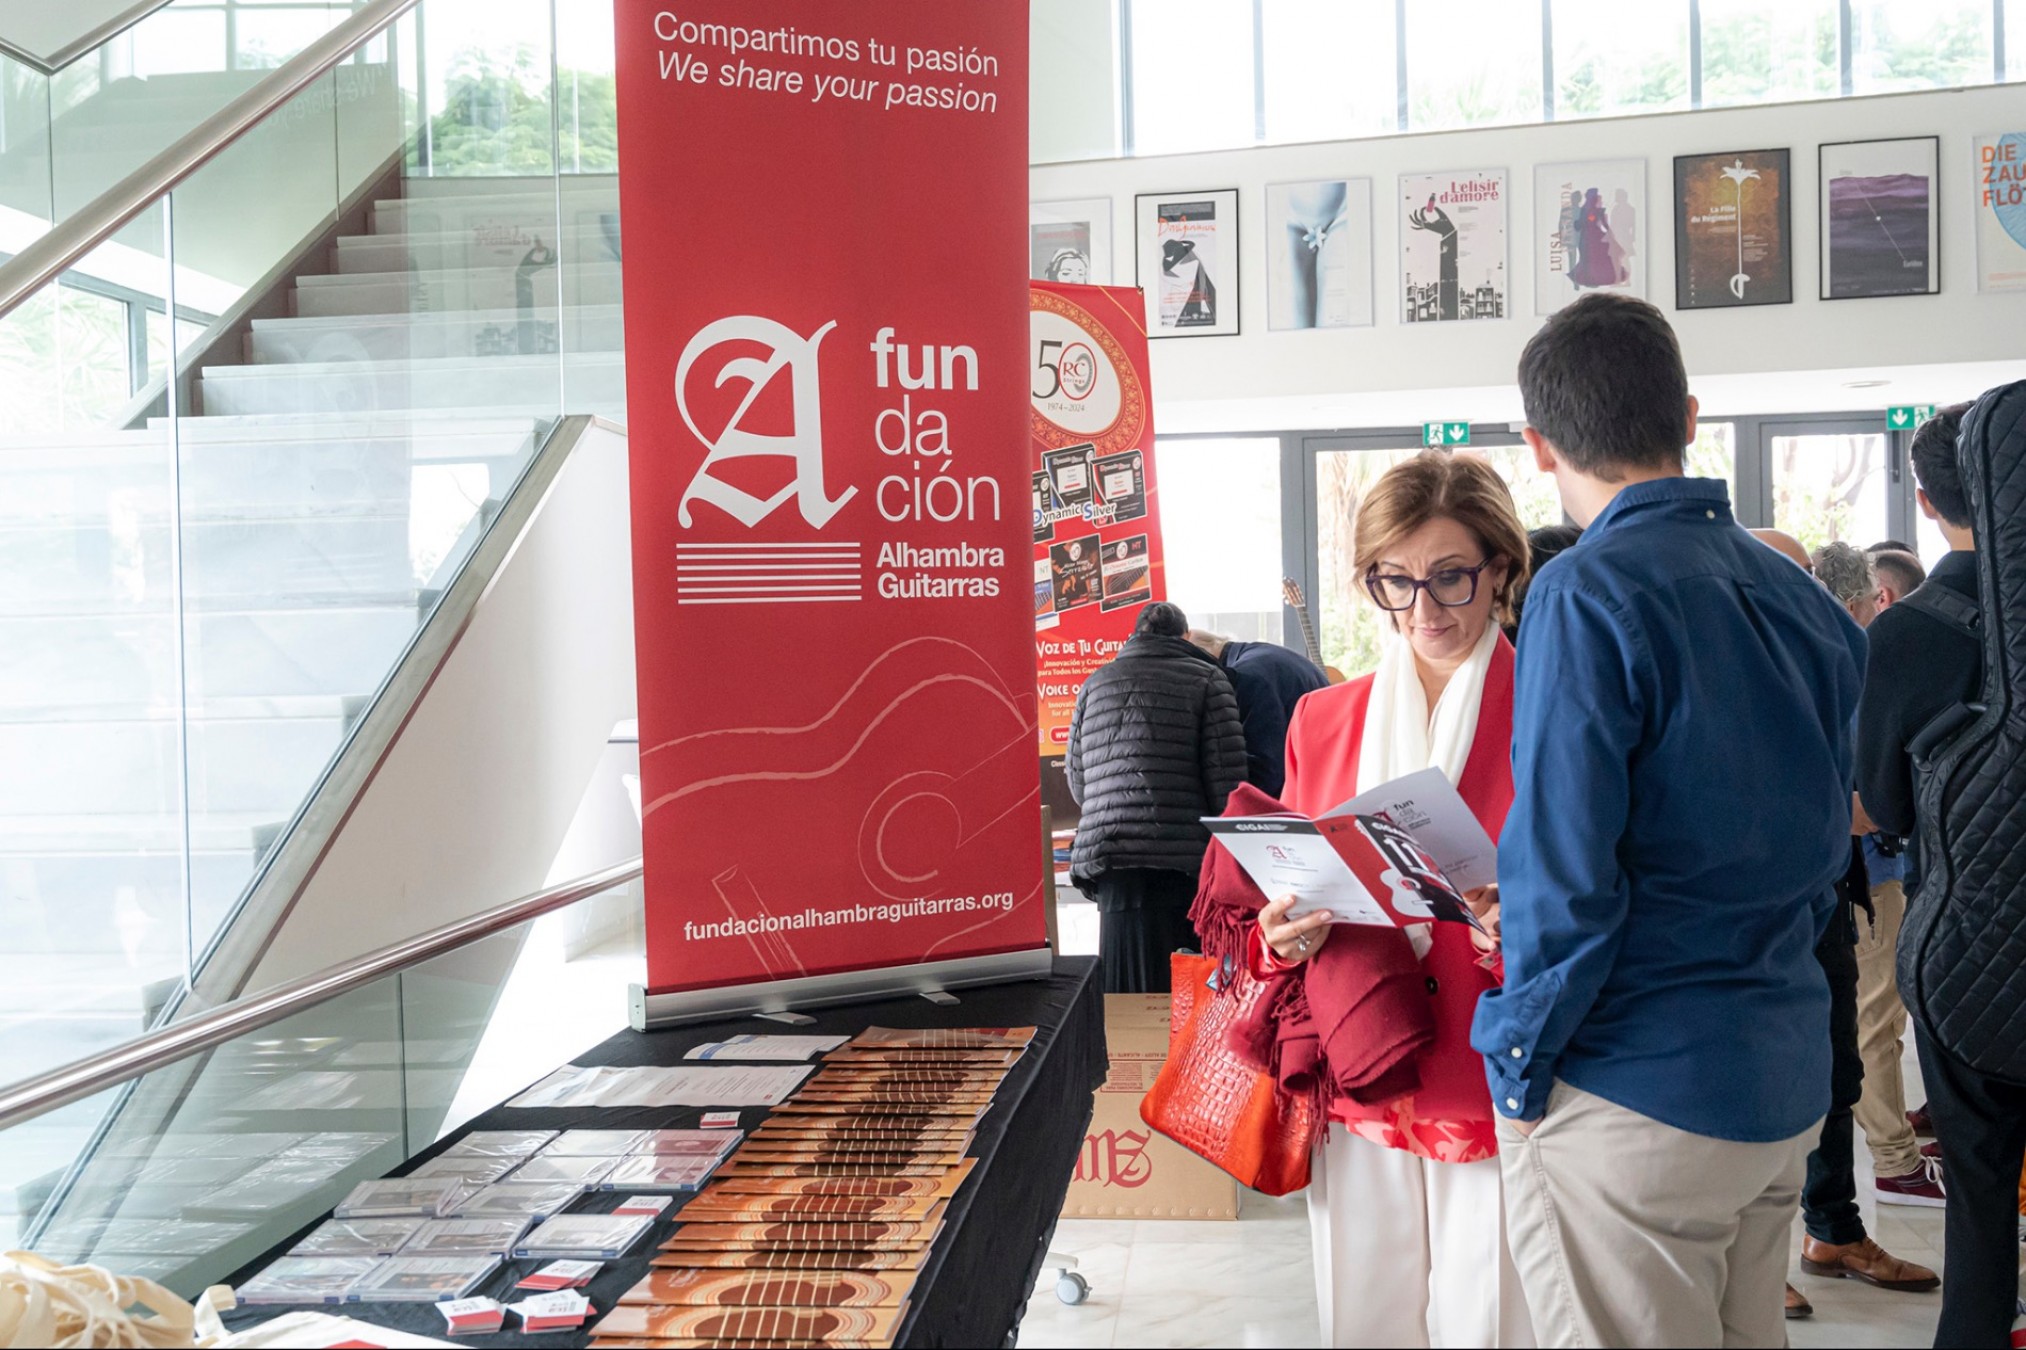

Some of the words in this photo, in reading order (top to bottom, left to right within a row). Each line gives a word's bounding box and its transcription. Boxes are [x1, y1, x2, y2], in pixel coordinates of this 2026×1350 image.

[654, 11, 860, 61] Compartimos
[868, 37, 896, 66] tu
[906, 46, 998, 77] pasión
[659, 50, 709, 84] We
[718, 59, 803, 94] share
[811, 73, 880, 102] your
[885, 82, 997, 113] passion
[1981, 144, 2017, 163] DIE
[1983, 183, 2026, 207] FLÖ
[1550, 232, 1562, 271] LUISA
[870, 327, 979, 391] fun
[1063, 361, 1086, 378] RC
[875, 394, 953, 456] da
[876, 459, 1001, 522] ción
[1083, 502, 1116, 519] Silver
[876, 541, 1005, 568] Alhambra
[877, 572, 1000, 599] Guitarras
[1393, 799, 1415, 811] fun
[684, 892, 1014, 941] fundacionalhambraguitarras.org
